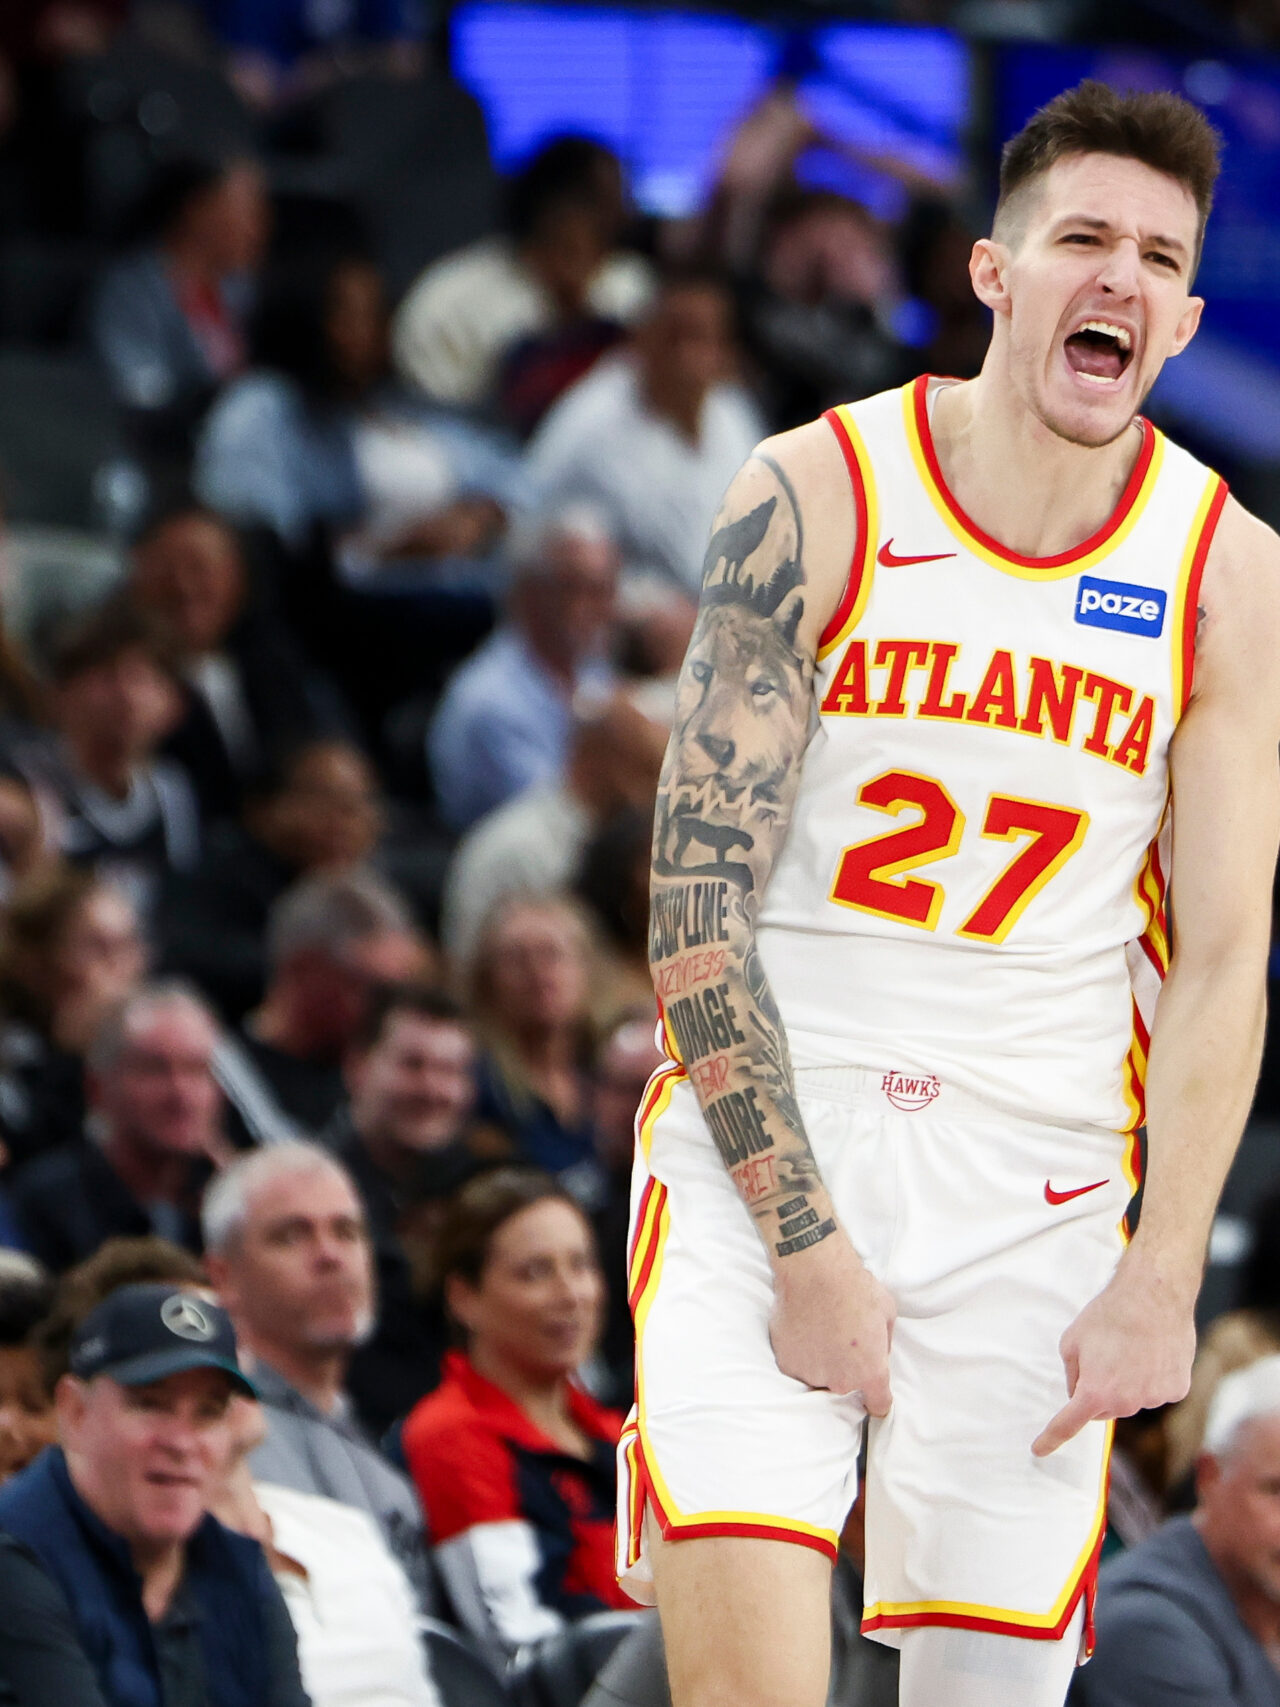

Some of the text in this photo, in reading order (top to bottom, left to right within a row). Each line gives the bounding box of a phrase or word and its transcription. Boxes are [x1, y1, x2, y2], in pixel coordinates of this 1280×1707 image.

[1080, 588, 1160, 622] paze
[819, 639, 1157, 779] ATLANTA
[828, 767, 1091, 945] 27
[880, 1074, 941, 1098] HAWKS
